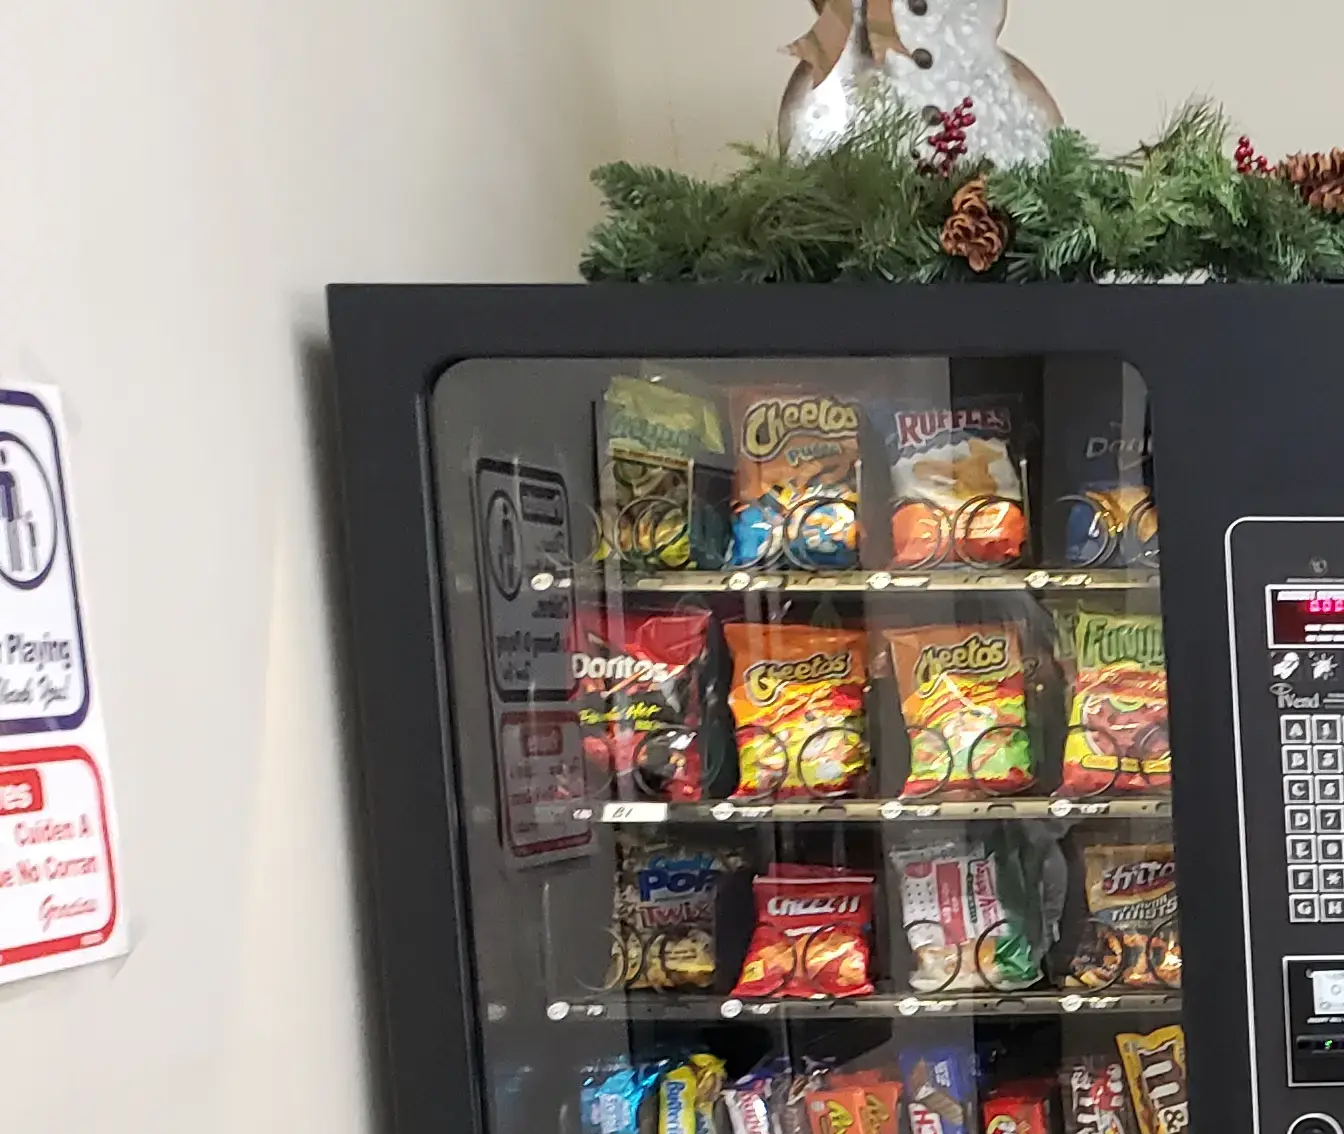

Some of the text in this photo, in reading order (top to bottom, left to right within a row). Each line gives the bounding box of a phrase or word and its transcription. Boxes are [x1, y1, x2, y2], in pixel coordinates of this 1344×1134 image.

[744, 398, 861, 460] Cheetos
[897, 406, 1012, 448] RUFFLES
[572, 652, 669, 683] Doritos
[1103, 860, 1177, 894] Frito
